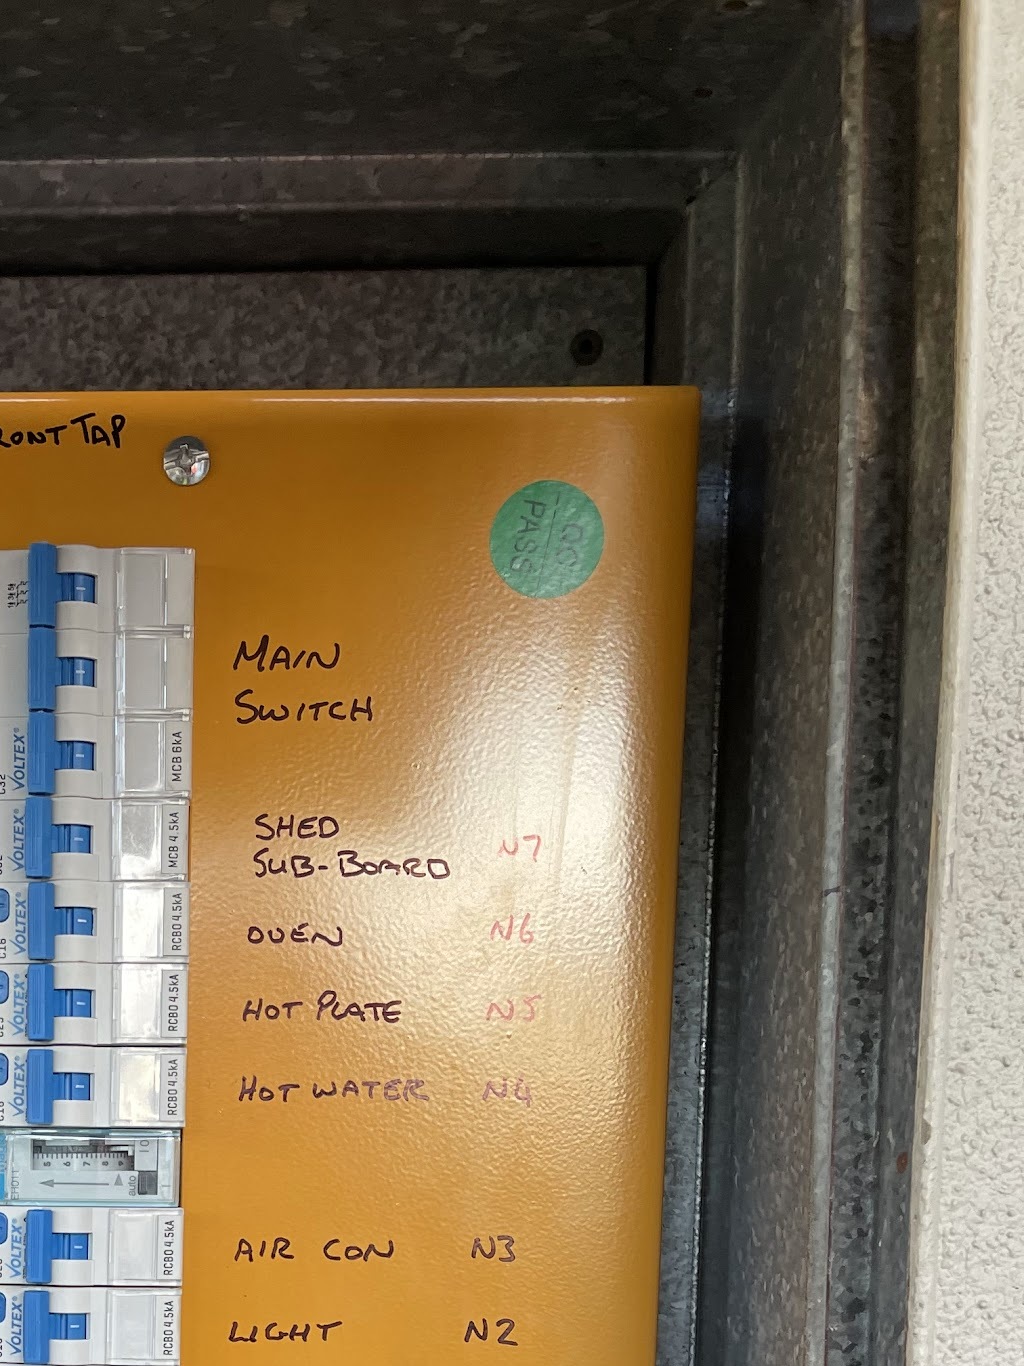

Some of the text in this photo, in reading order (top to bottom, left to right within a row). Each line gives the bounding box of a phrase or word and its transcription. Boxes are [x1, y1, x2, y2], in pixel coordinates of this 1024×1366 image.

[70, 411, 127, 450] TAP
[509, 498, 547, 573] PASS
[232, 634, 341, 673] MAIN
[233, 688, 373, 725] SWITCH
[172, 731, 182, 782] MCB 6kA
[168, 811, 179, 868] MCB 4.5kA
[254, 813, 340, 841] SHED
[171, 892, 182, 951] RCBO 4.5kA
[490, 913, 535, 944] N6
[168, 973, 179, 1032] RCBO 4.5kA
[242, 990, 542, 1024] HOT PLATE N5
[168, 1058, 179, 1116] RCBO 4.5kA
[238, 1075, 300, 1103] HOT
[312, 1078, 430, 1101] WATER
[128, 1175, 137, 1197] auto
[163, 1220, 175, 1276] RCBO 4.5kA
[234, 1235, 516, 1262] AIR CON N3
[163, 1300, 174, 1356] RCBO 4.5kA
[228, 1318, 518, 1346] LIGHT N2
